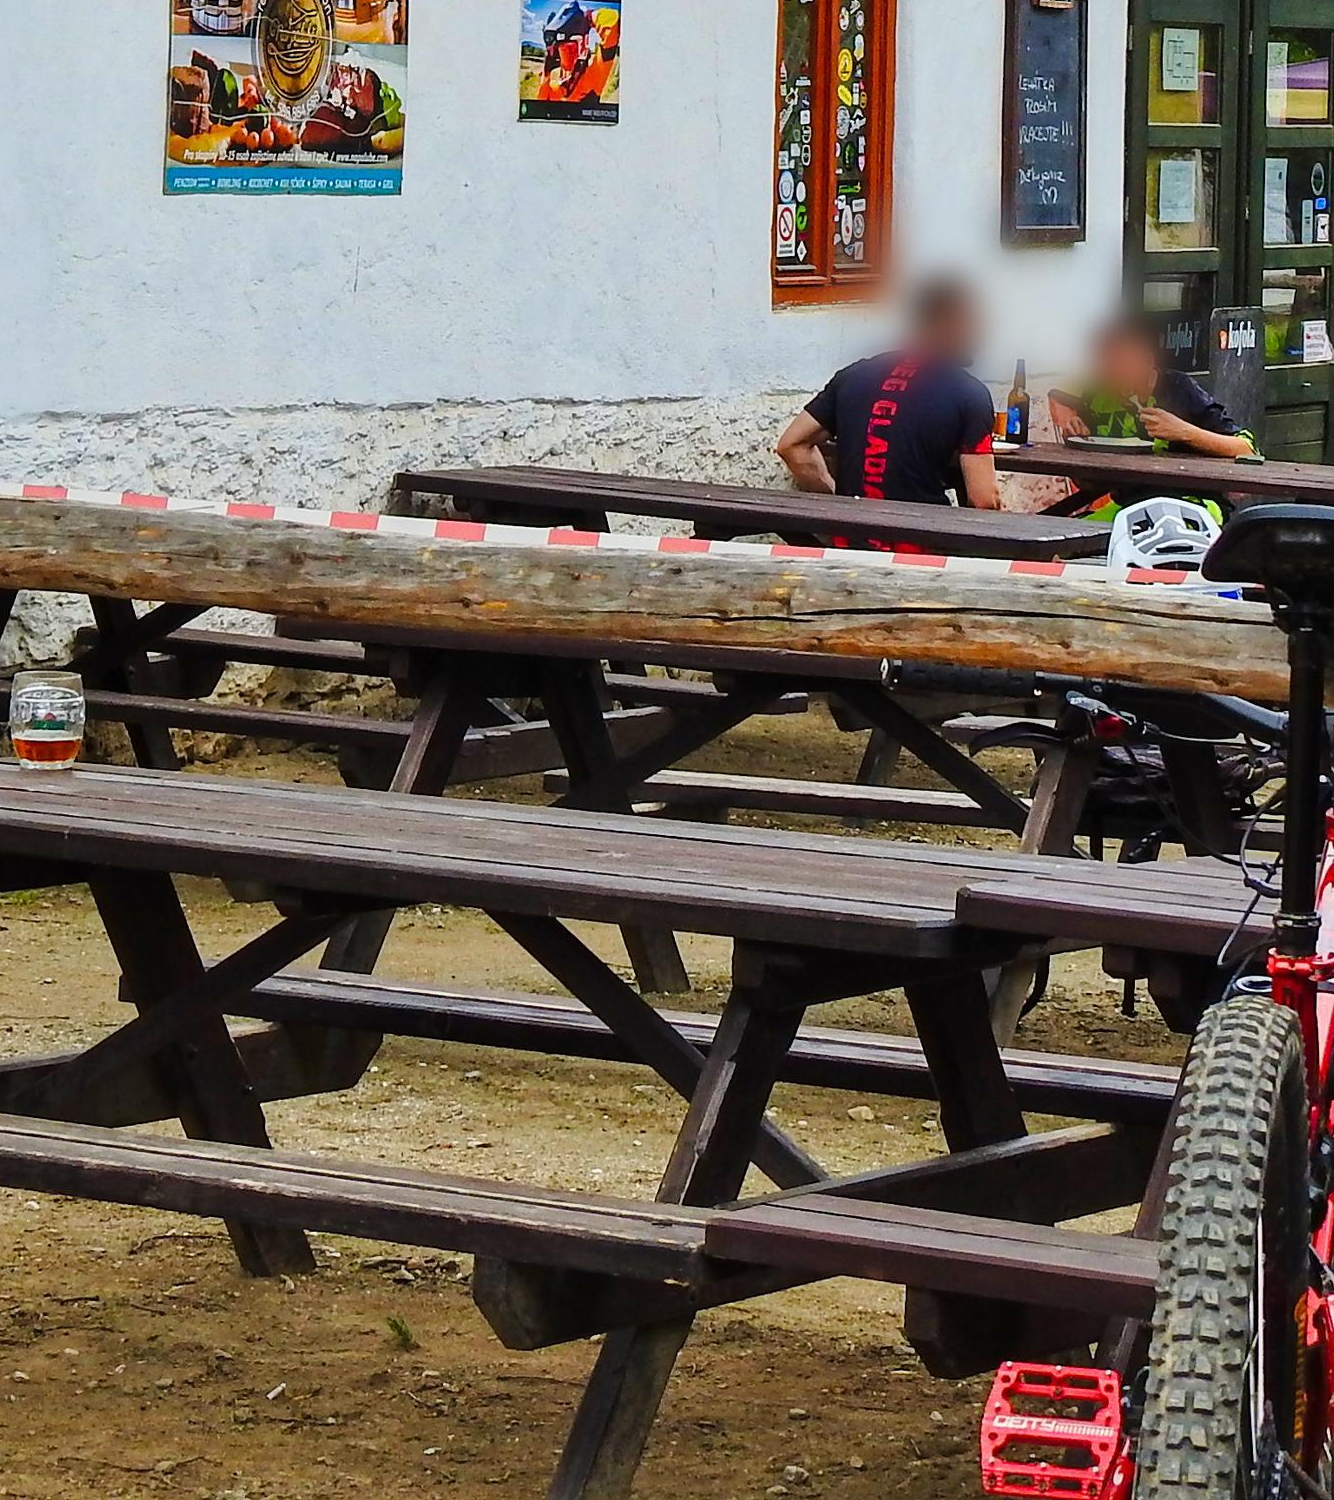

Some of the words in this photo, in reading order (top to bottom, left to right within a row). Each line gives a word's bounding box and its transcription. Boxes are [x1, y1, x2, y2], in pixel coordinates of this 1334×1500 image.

[1227, 320, 1257, 357] kofola
[863, 399, 898, 500] GLADIA
[993, 1414, 1058, 1433] DEITY
